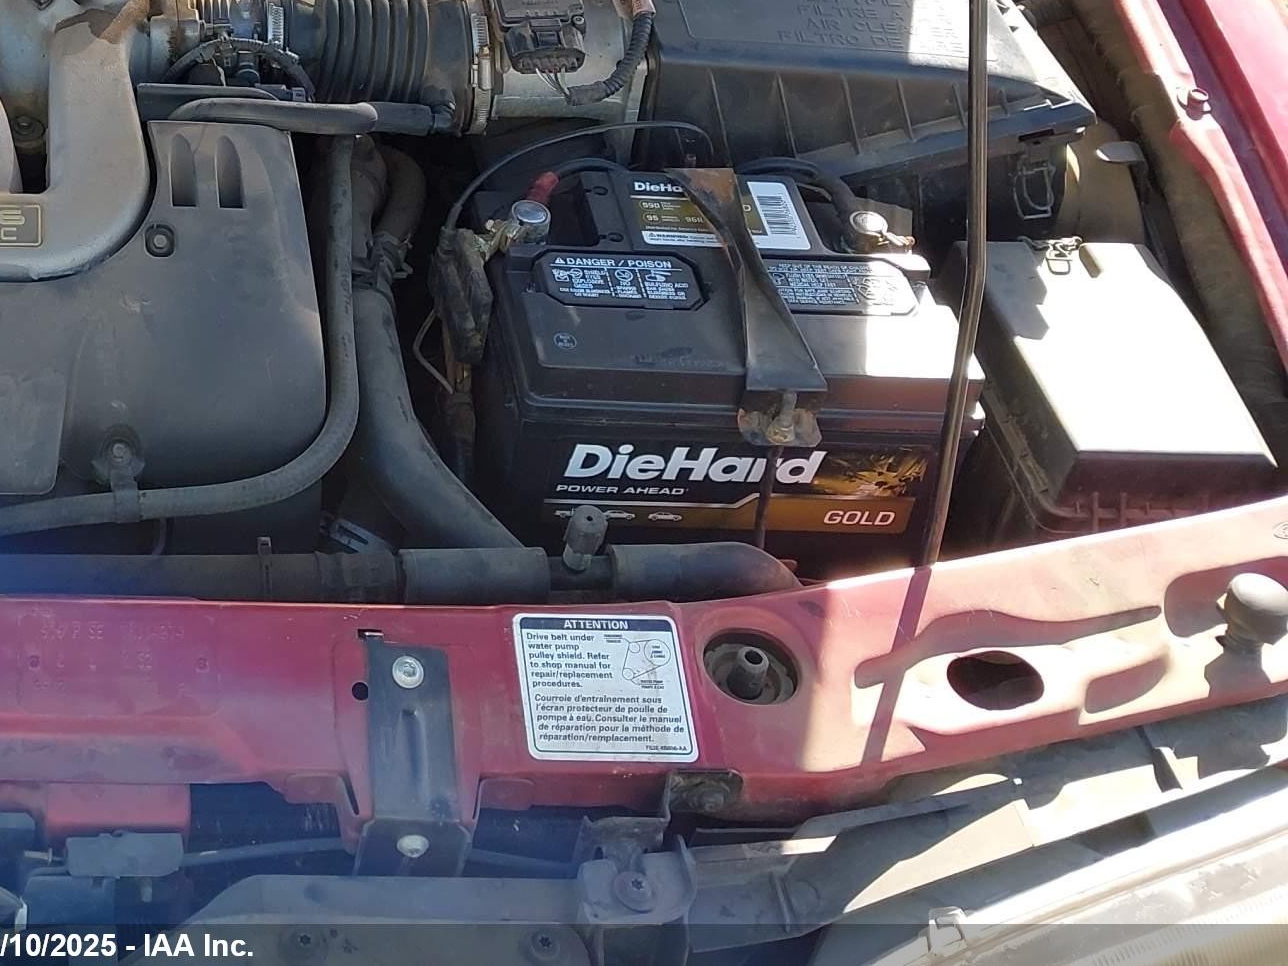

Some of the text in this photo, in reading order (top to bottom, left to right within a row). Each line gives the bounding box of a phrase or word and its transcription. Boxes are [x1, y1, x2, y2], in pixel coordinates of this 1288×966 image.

[808, 17, 840, 31] AIR
[633, 182, 684, 192] DieHa
[566, 258, 615, 266] DANGER
[627, 260, 672, 268] POISON
[563, 443, 826, 484] DieHard
[556, 484, 686, 495] POWER AHEAD
[823, 509, 896, 526] GOLD
[564, 620, 628, 629] ATTENTION
[529, 652, 554, 660] pulley
[542, 661, 562, 669] shop
[531, 670, 613, 679] repair/replacement
[535, 694, 572, 702] Courroie
[567, 704, 612, 713] protecteur
[615, 705, 625, 713] de
[639, 715, 646, 723] le
[551, 724, 596, 732] réparation
[539, 733, 654, 743] réparation/remplacement.
